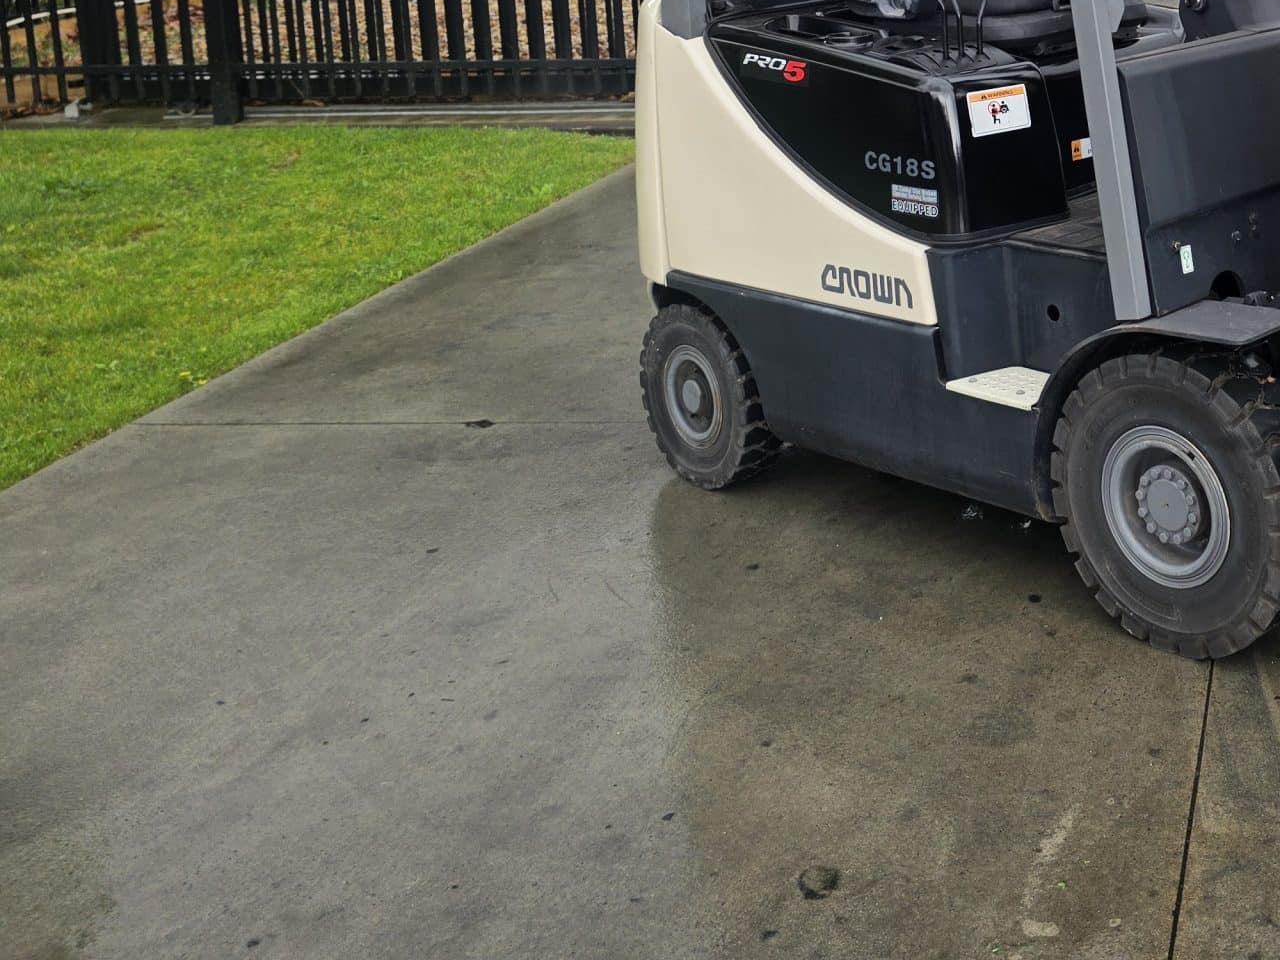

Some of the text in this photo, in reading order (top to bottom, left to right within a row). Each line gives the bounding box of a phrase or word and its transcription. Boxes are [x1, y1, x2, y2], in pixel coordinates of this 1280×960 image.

[864, 150, 936, 180] CG18S
[891, 199, 939, 218] EQUIPPED
[821, 263, 913, 309] CROWN
